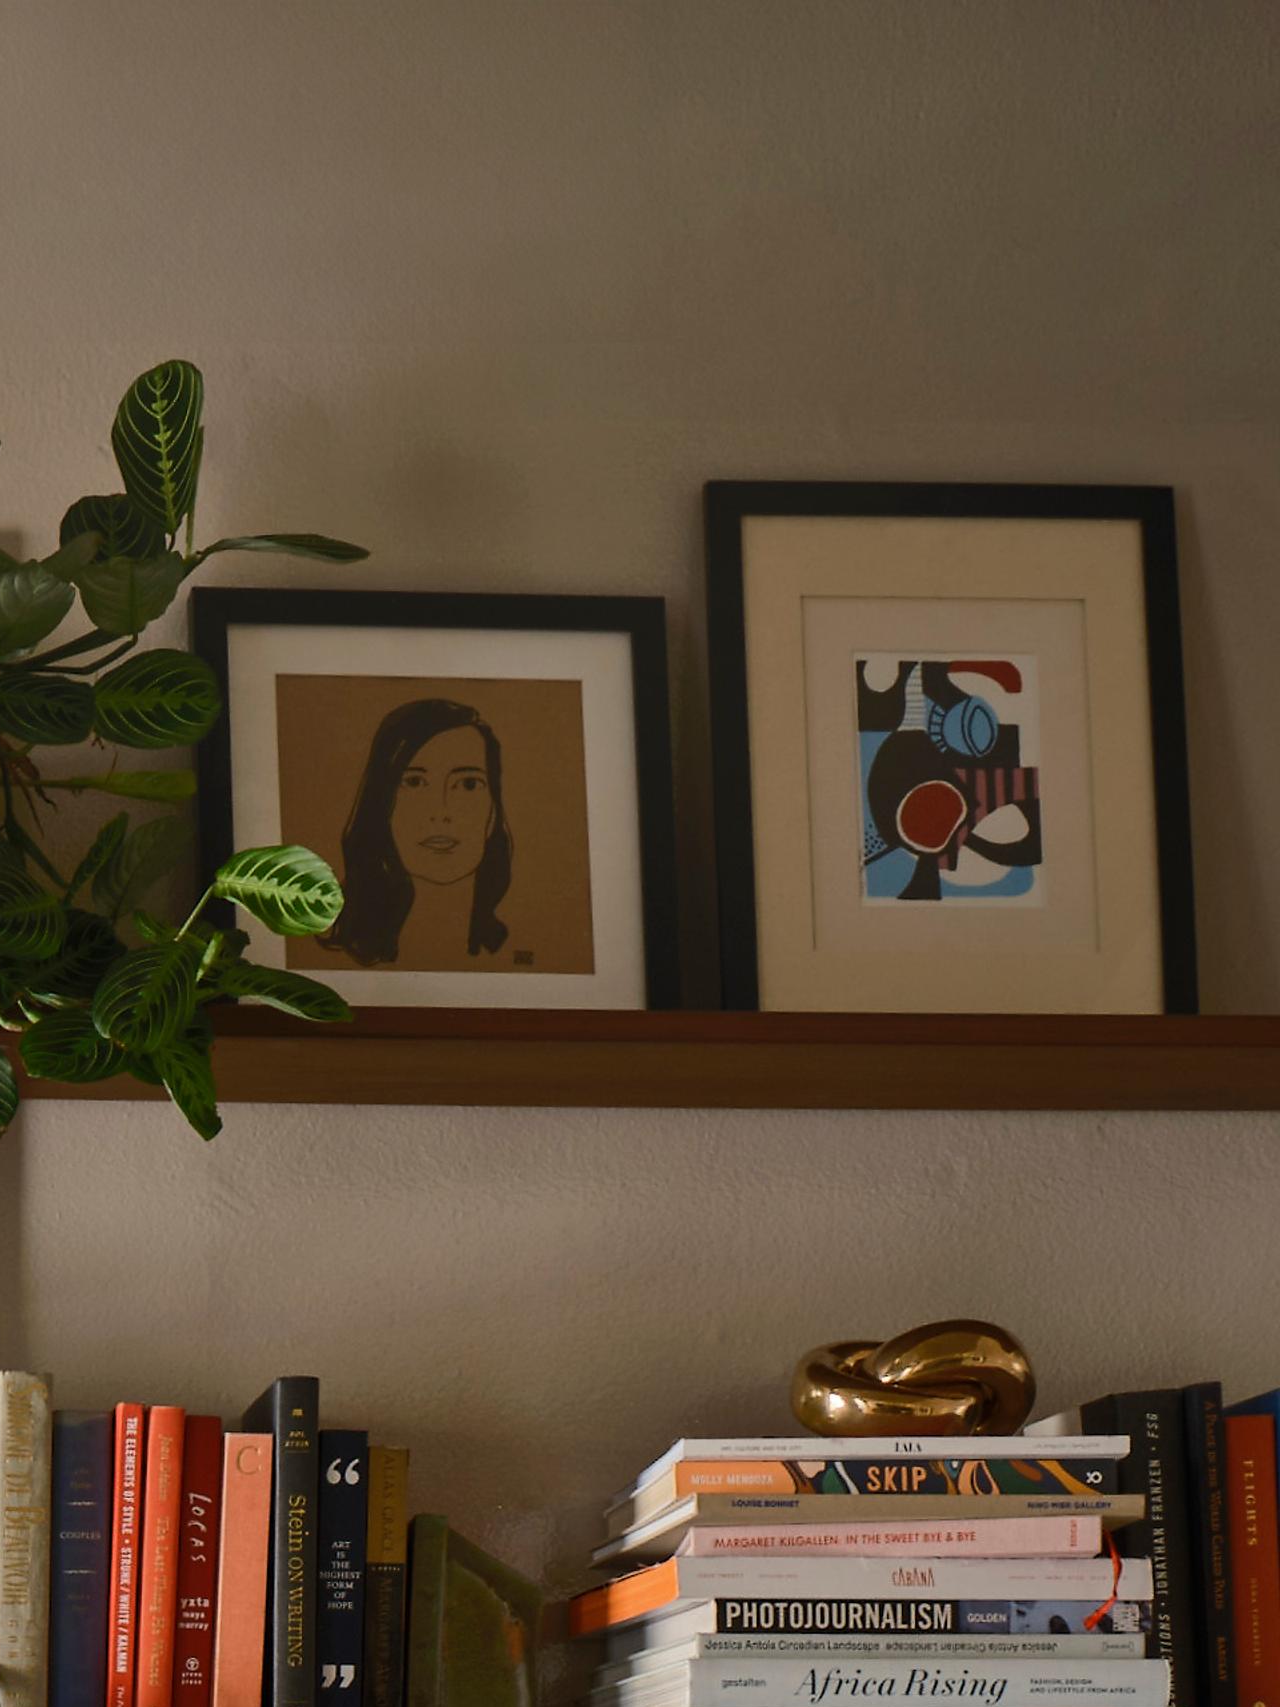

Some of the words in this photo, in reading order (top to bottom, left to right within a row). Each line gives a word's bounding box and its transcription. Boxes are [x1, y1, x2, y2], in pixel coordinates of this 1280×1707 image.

[125, 1417, 138, 1436] THE
[122, 1439, 137, 1487] ELEMENTS
[866, 1466, 927, 1492] SKIP
[122, 1490, 134, 1503] OF
[1243, 1459, 1259, 1546] FLIGHTS
[122, 1505, 134, 1535] STYLE
[288, 1495, 309, 1552] Stein
[332, 1541, 351, 1549] ART
[288, 1556, 304, 1582] ON
[331, 1561, 350, 1569] THE
[287, 1586, 304, 1668] WRITING
[724, 1602, 952, 1630] PHOTOJOURNALISM
[966, 1613, 1007, 1623] GOLDEN
[721, 1675, 766, 1688] gestalten
[793, 1667, 896, 1706] Africa
[902, 1668, 1008, 1705] Rising
